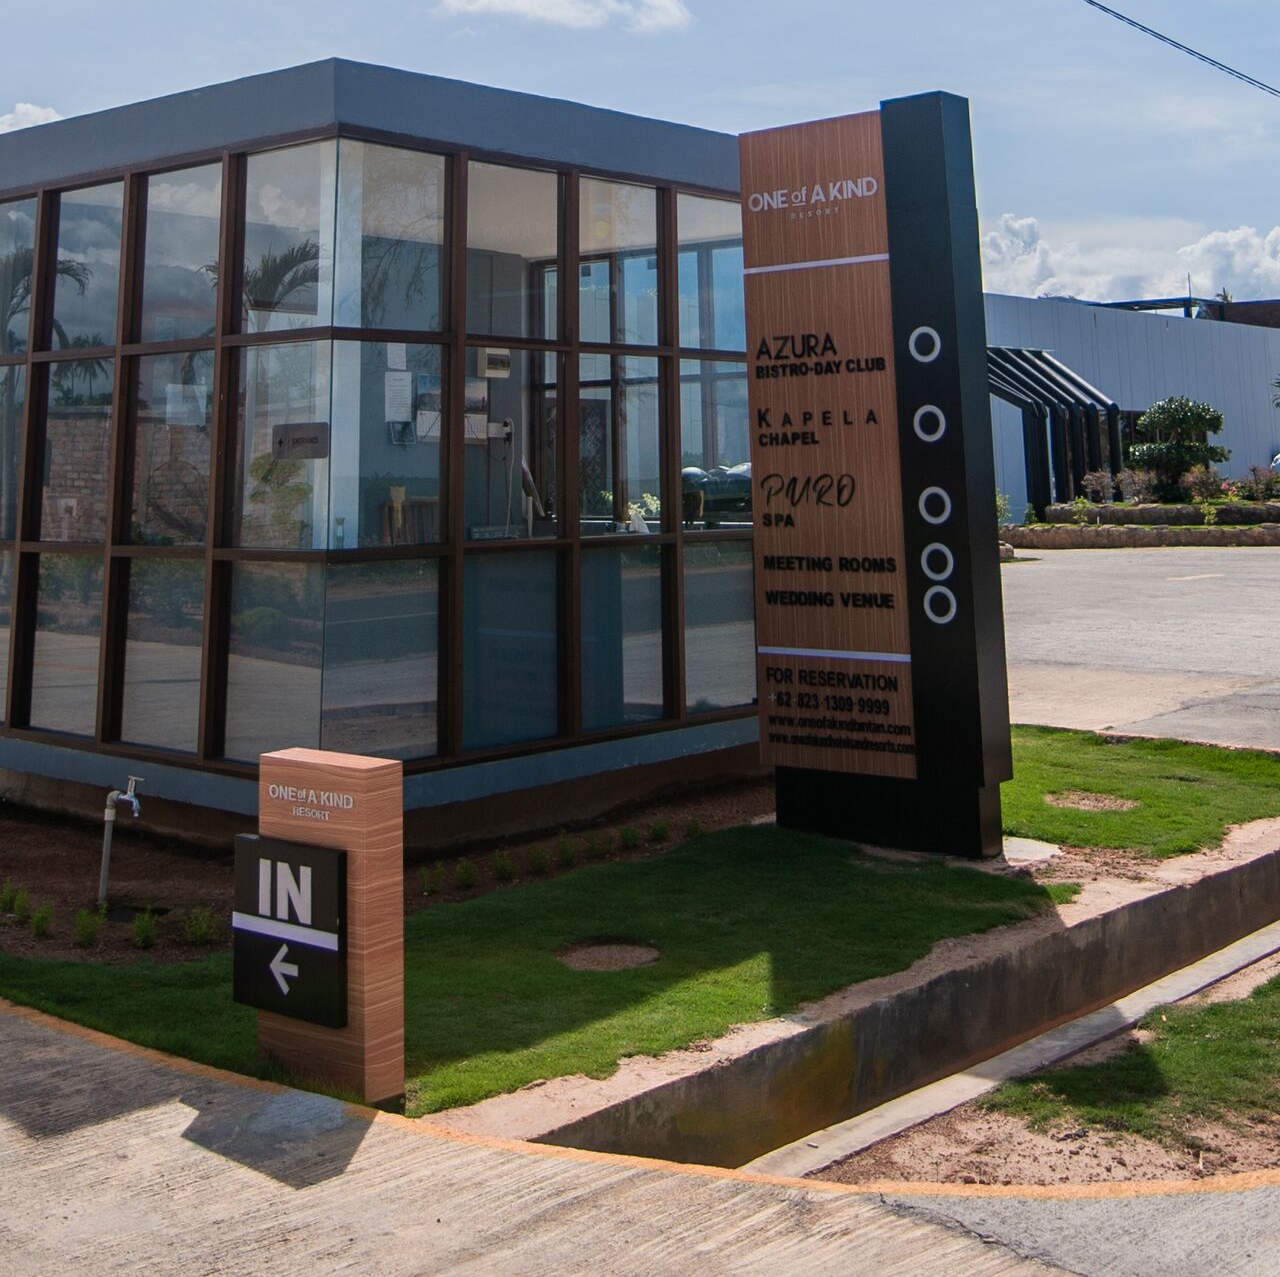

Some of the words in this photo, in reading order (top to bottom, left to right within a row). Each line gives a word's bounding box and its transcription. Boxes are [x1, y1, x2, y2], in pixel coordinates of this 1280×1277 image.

[748, 189, 789, 212] ONE
[791, 186, 807, 206] of
[811, 184, 826, 204] A
[829, 177, 878, 201] KIND
[790, 207, 839, 219] RESORT
[756, 333, 837, 361] AZURA
[756, 360, 841, 379] BISTRO-DAY
[845, 358, 886, 374] CLUB
[758, 430, 819, 447] CHAPEL
[761, 473, 856, 508] PURO
[762, 512, 795, 528] SPA
[763, 554, 832, 572] MEETING
[839, 556, 897, 573] ROOMS
[765, 590, 834, 607] WEDDING
[841, 592, 894, 609] VENUE
[766, 667, 793, 684] FOR
[799, 669, 898, 692] RESERVATION
[269, 784, 297, 801] ONE
[297, 788, 307, 802] of
[307, 789, 317, 804] A
[320, 791, 353, 809] KIND
[292, 806, 330, 820] RESORT
[258, 858, 312, 925] IN
